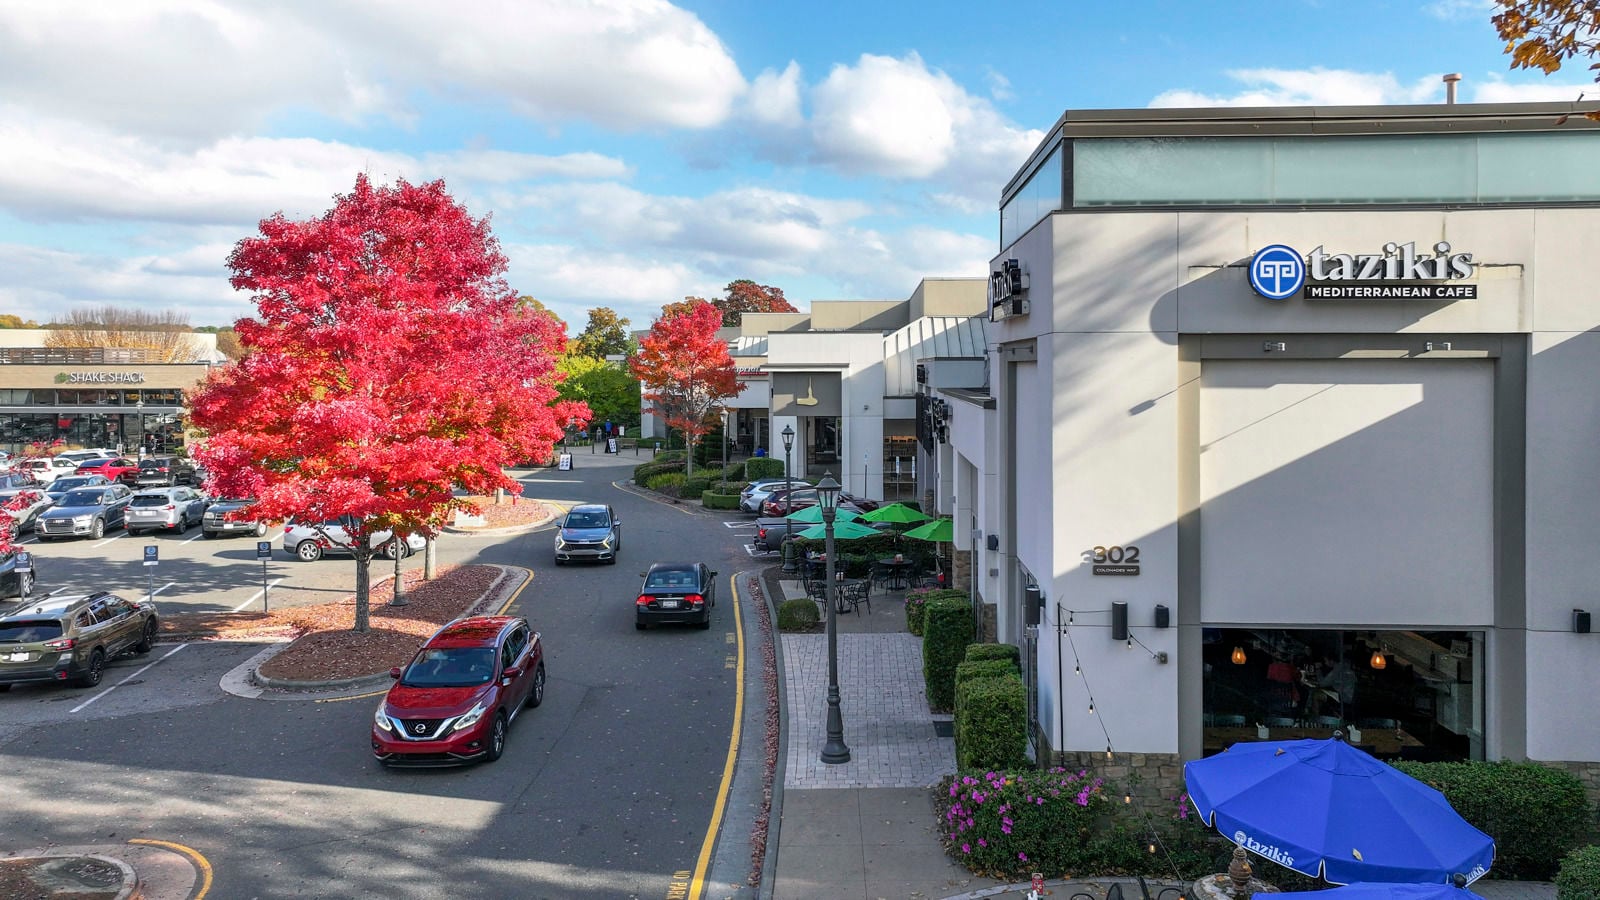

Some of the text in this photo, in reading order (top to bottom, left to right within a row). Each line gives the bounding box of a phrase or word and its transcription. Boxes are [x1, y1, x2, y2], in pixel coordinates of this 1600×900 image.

[1306, 241, 1473, 281] tazikis
[1311, 287, 1473, 297] MEDITERRANEAN CAFE
[70, 371, 145, 383] SHAKE SHACK
[1093, 546, 1139, 563] 302
[1247, 836, 1295, 867] tazikis
